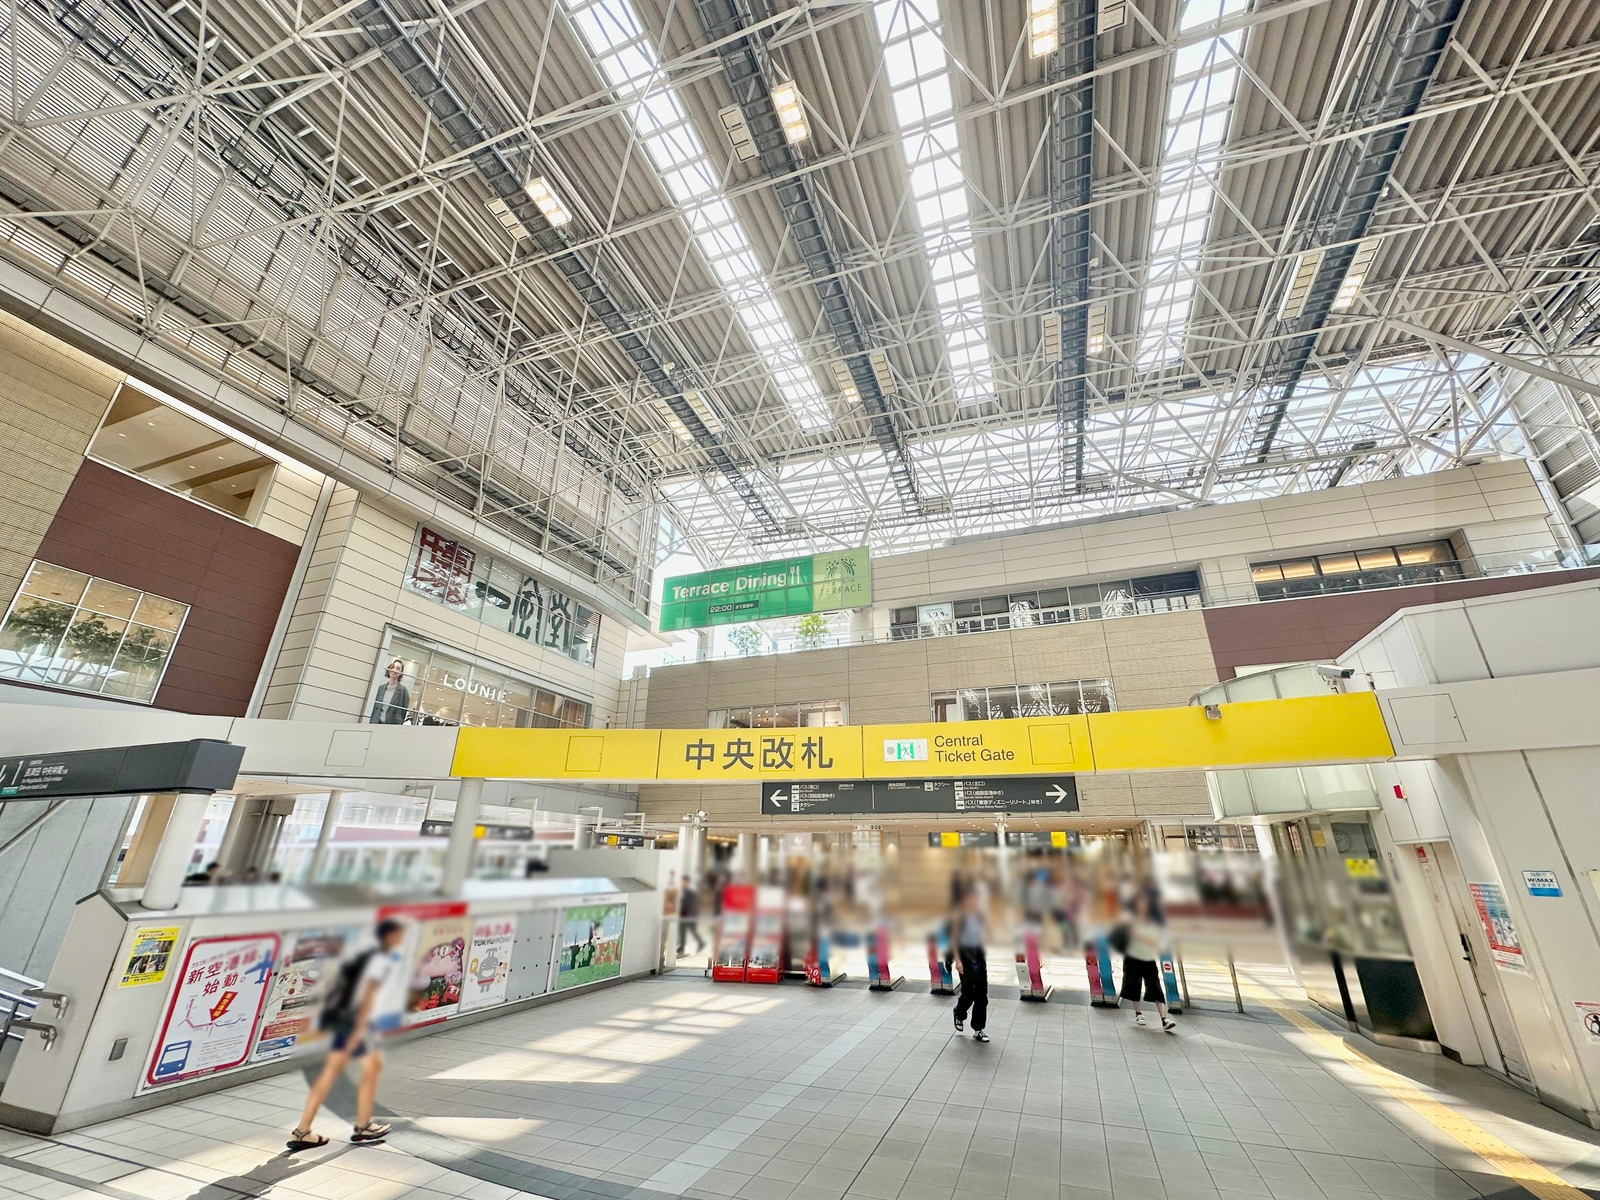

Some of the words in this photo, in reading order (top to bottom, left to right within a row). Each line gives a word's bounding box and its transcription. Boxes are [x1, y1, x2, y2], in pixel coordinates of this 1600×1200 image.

[672, 580, 730, 600] Terrace
[735, 571, 787, 592] Dining
[820, 583, 862, 596] TERRACE
[709, 604, 732, 613] 22:00
[443, 673, 507, 703] LOUNIE
[934, 734, 984, 749] Central
[684, 736, 834, 771] 中央改札
[936, 748, 979, 762] Ticket
[980, 747, 1015, 761] Gate
[473, 939, 495, 947] TOKYU
